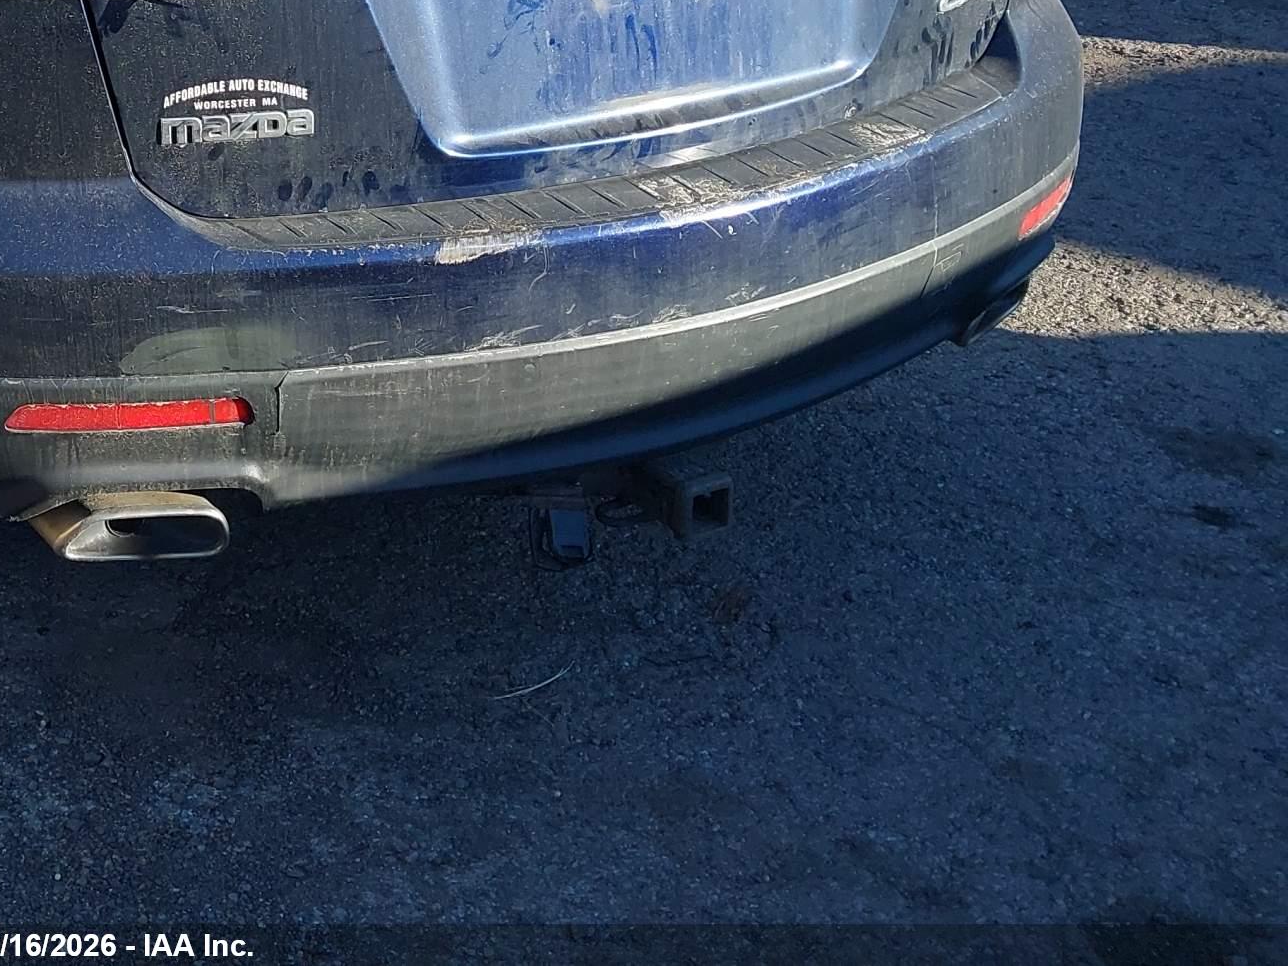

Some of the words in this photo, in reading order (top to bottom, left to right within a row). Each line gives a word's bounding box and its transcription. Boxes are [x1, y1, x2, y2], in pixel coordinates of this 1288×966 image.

[163, 80, 226, 109] AFFORDABLE
[228, 79, 255, 91] AUTO
[257, 79, 309, 101] EXCHANGE
[194, 99, 256, 111] WORCESTER
[262, 97, 278, 107] MA
